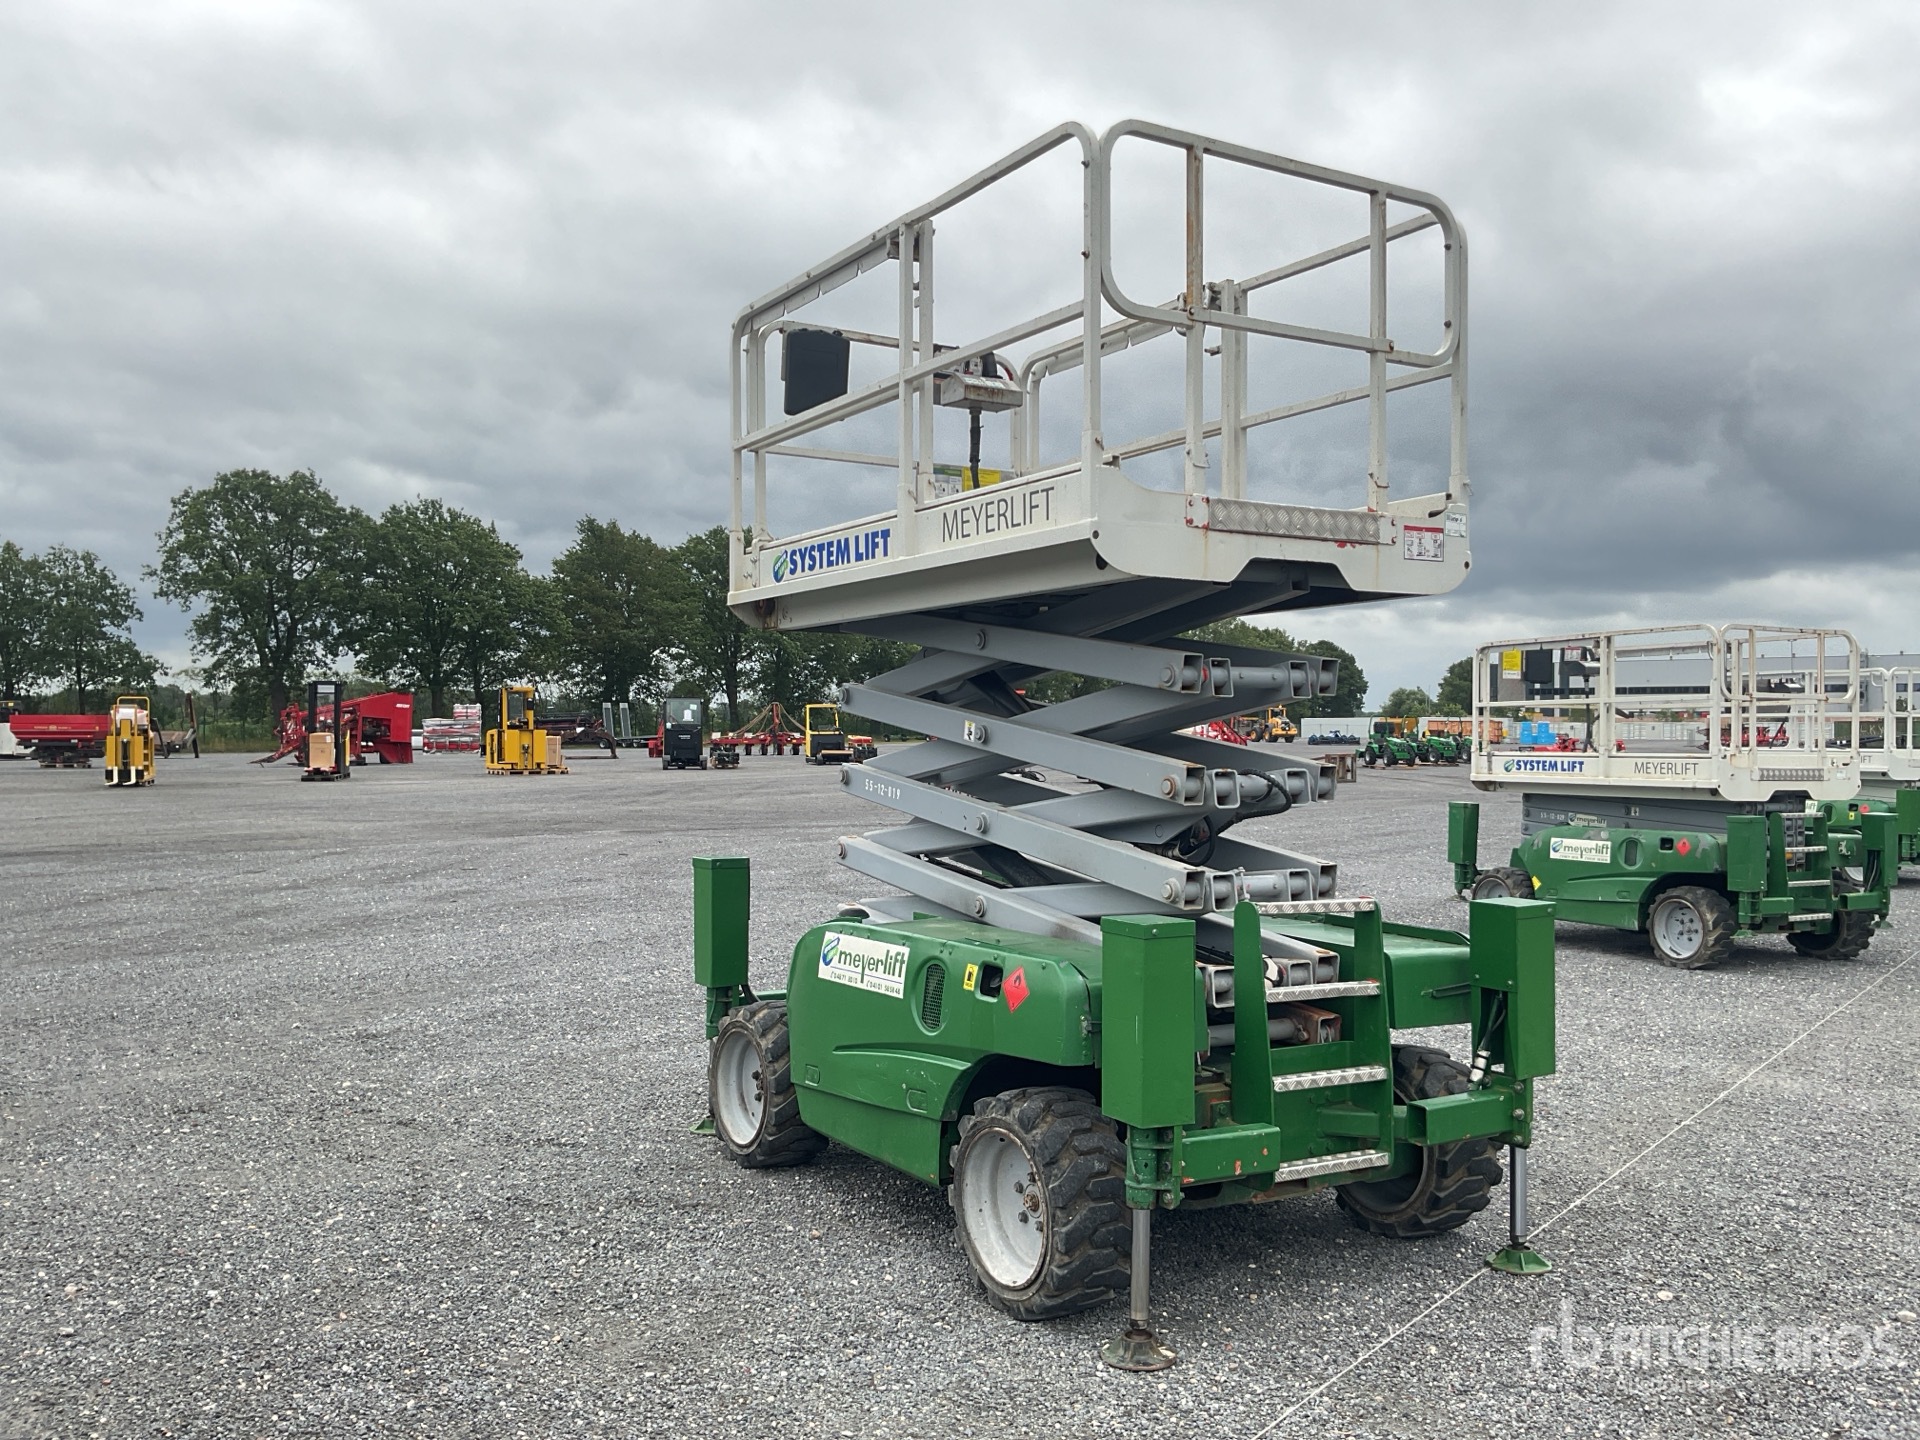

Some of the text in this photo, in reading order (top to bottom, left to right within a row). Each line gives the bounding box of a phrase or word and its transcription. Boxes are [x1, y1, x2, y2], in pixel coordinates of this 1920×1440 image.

[942, 486, 1054, 543] MEYERLIFT
[789, 536, 850, 576] SYSTEM
[854, 528, 891, 562] LIFT
[1516, 760, 1584, 772] SYSTEM LIFT
[1634, 762, 1699, 776] MEYERLIFT
[1563, 843, 1610, 859] meyerlift
[838, 949, 905, 984] meyerlift
